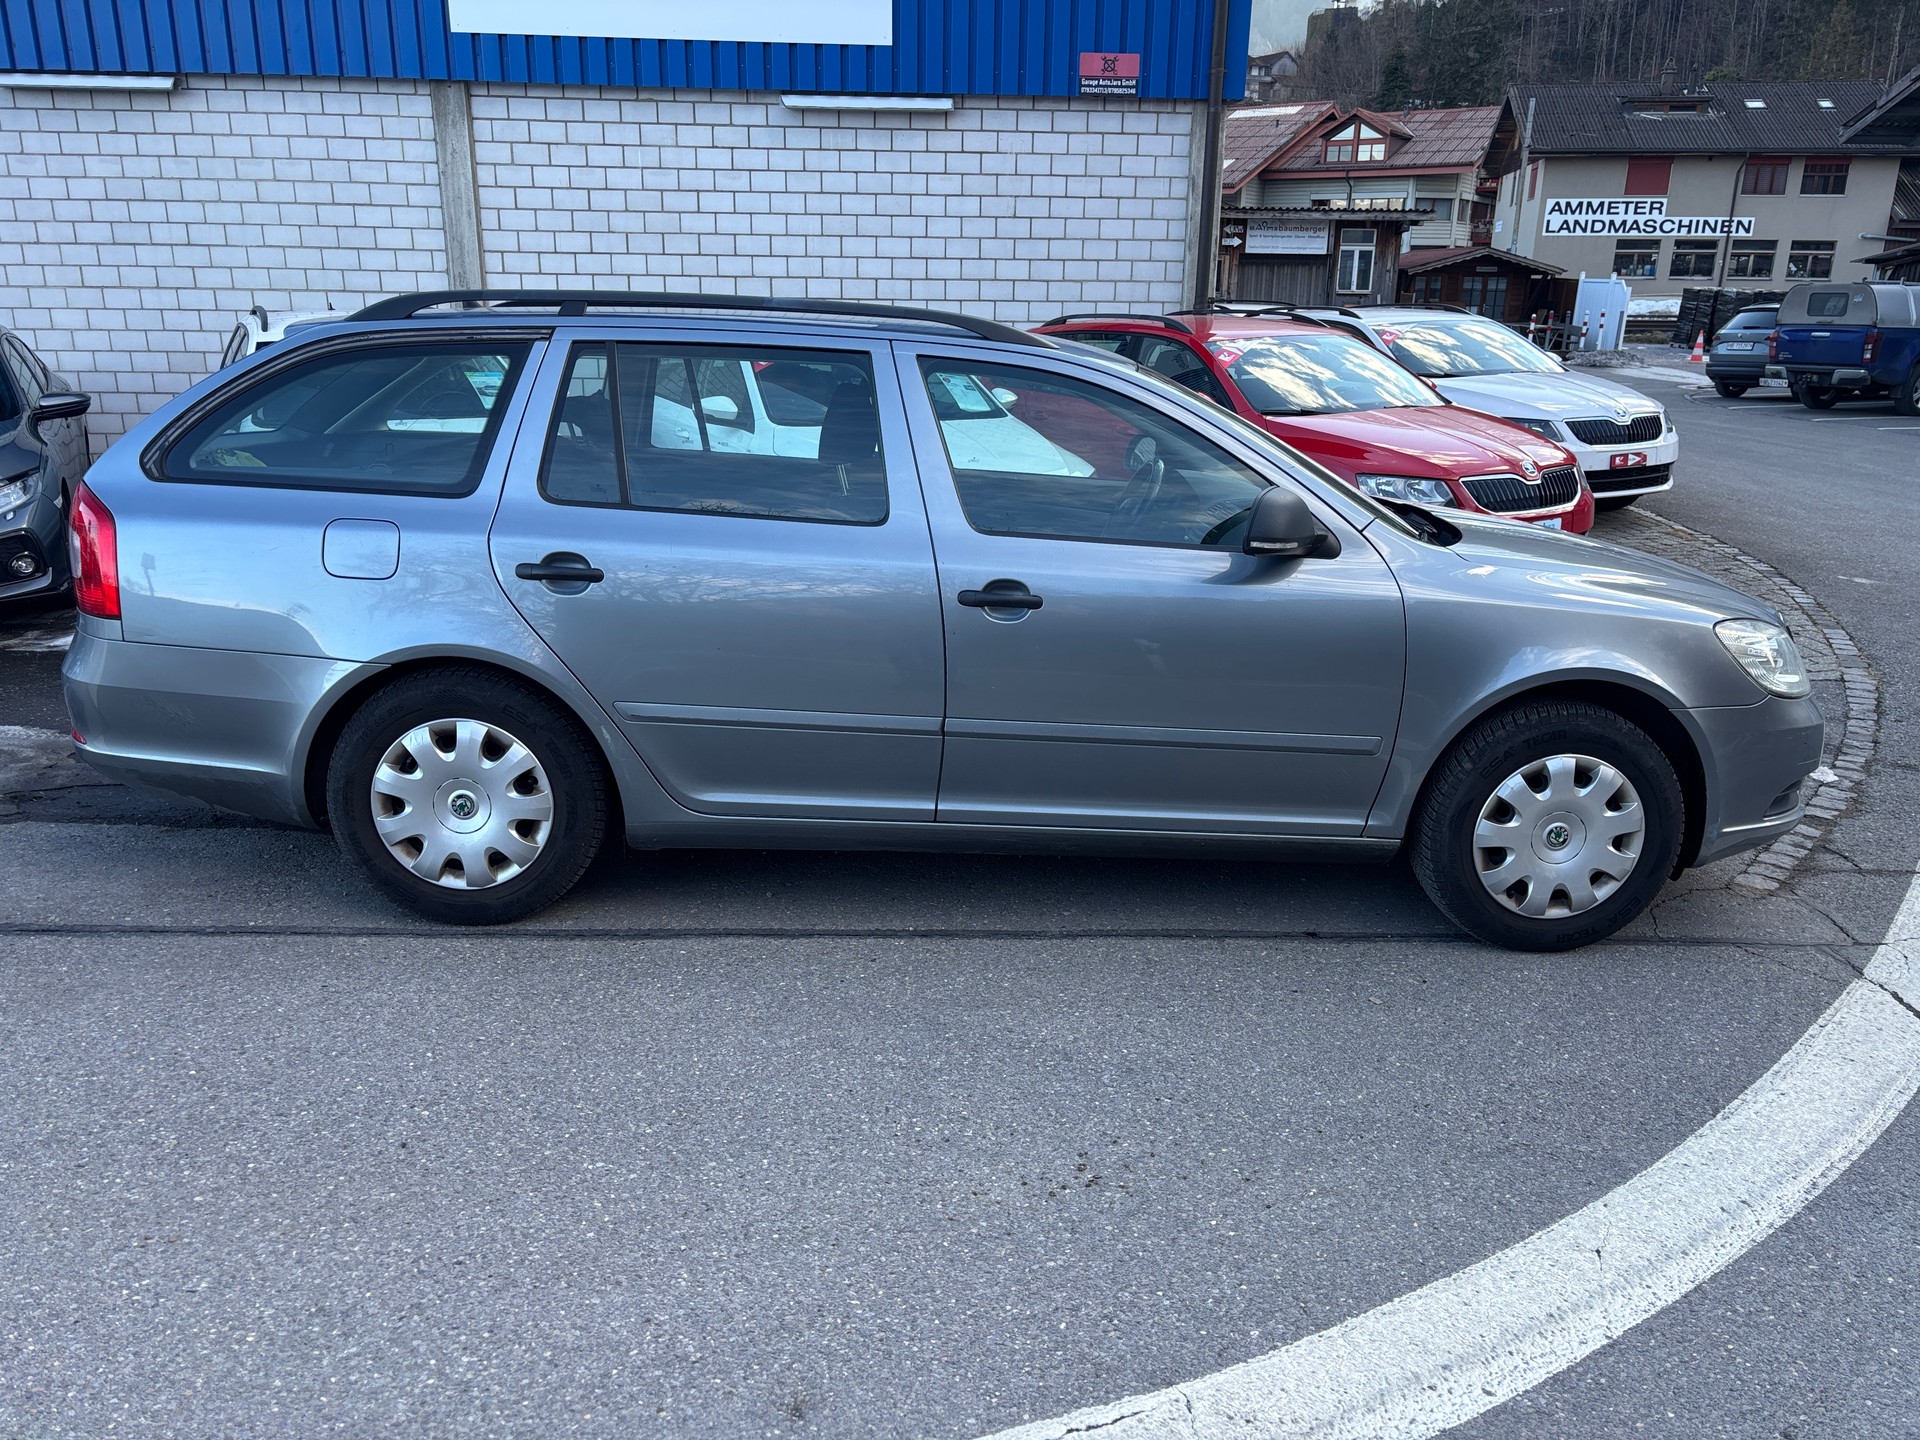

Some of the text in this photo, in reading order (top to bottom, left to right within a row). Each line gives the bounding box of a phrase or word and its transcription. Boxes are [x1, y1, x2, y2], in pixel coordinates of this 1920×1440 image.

[1081, 78, 1098, 86] Garage
[1547, 200, 1665, 216] AMMETER
[1278, 223, 1326, 234] baumberger
[1544, 218, 1754, 234] LANDMASCHINEN
[1522, 729, 1568, 749] TECAR
